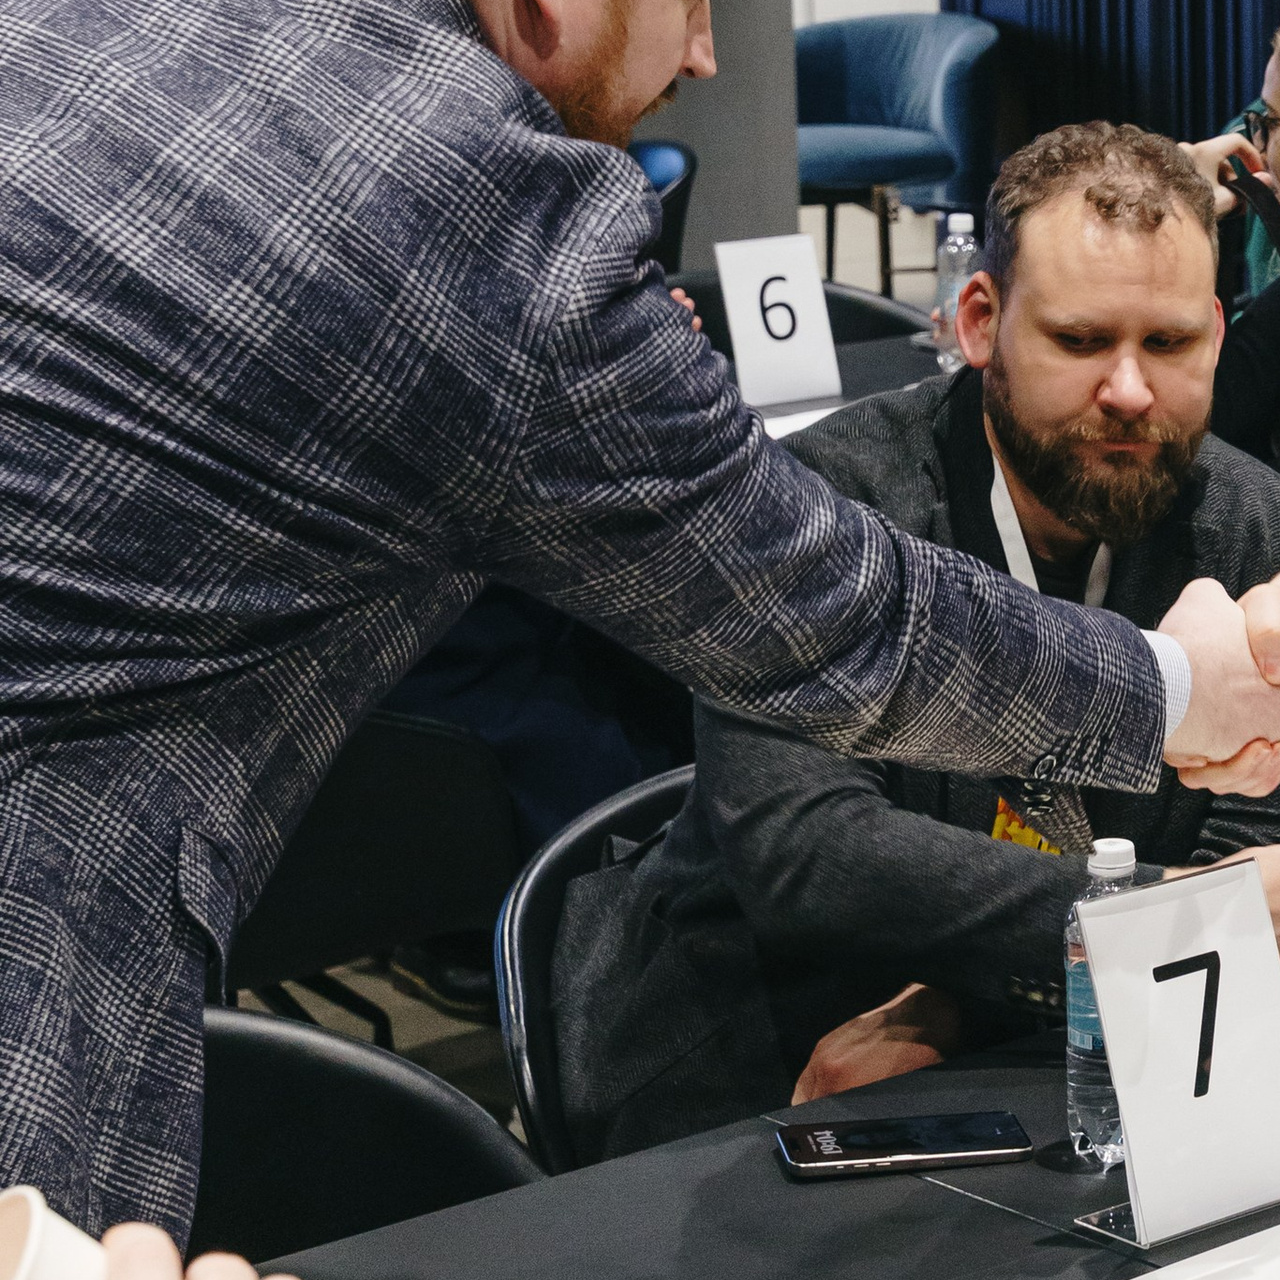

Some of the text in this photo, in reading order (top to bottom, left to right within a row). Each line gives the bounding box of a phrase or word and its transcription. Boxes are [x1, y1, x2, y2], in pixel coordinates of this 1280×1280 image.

[759, 276, 797, 341] 6
[1152, 950, 1221, 1098] 7
[813, 1130, 843, 1155] 19:04
